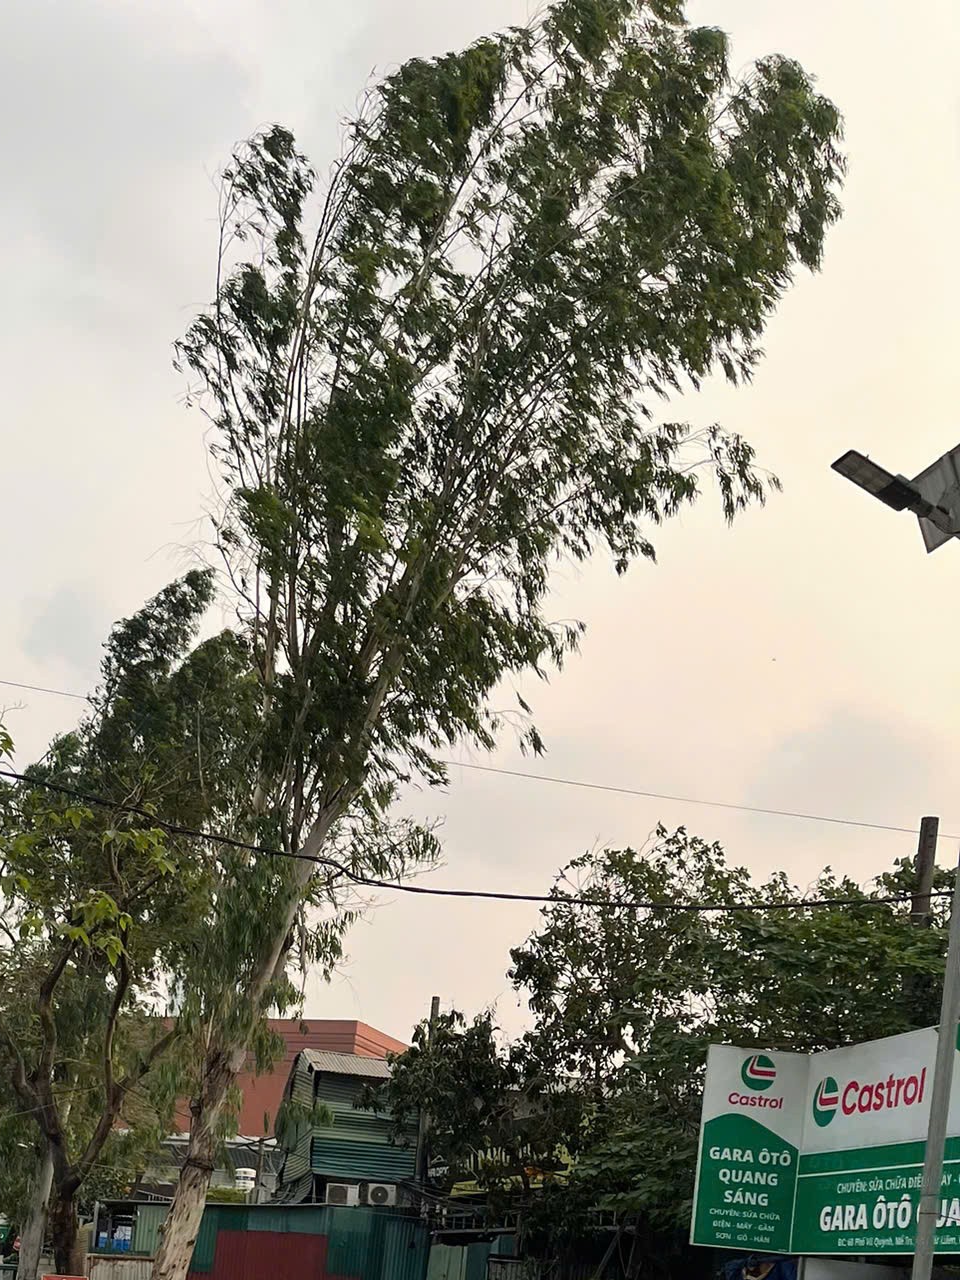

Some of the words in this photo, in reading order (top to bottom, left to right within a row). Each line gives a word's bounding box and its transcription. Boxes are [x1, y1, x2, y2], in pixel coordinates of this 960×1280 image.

[841, 1067, 927, 1115] Castrol
[728, 1092, 783, 1109] Castrol
[709, 1147, 754, 1163] GARA
[758, 1148, 792, 1166] ÔTÔ
[719, 1169, 778, 1186] QUANG
[723, 1188, 769, 1206] SÁNG
[820, 1203, 868, 1231] GARA
[872, 1194, 912, 1229] ÔTÔ
